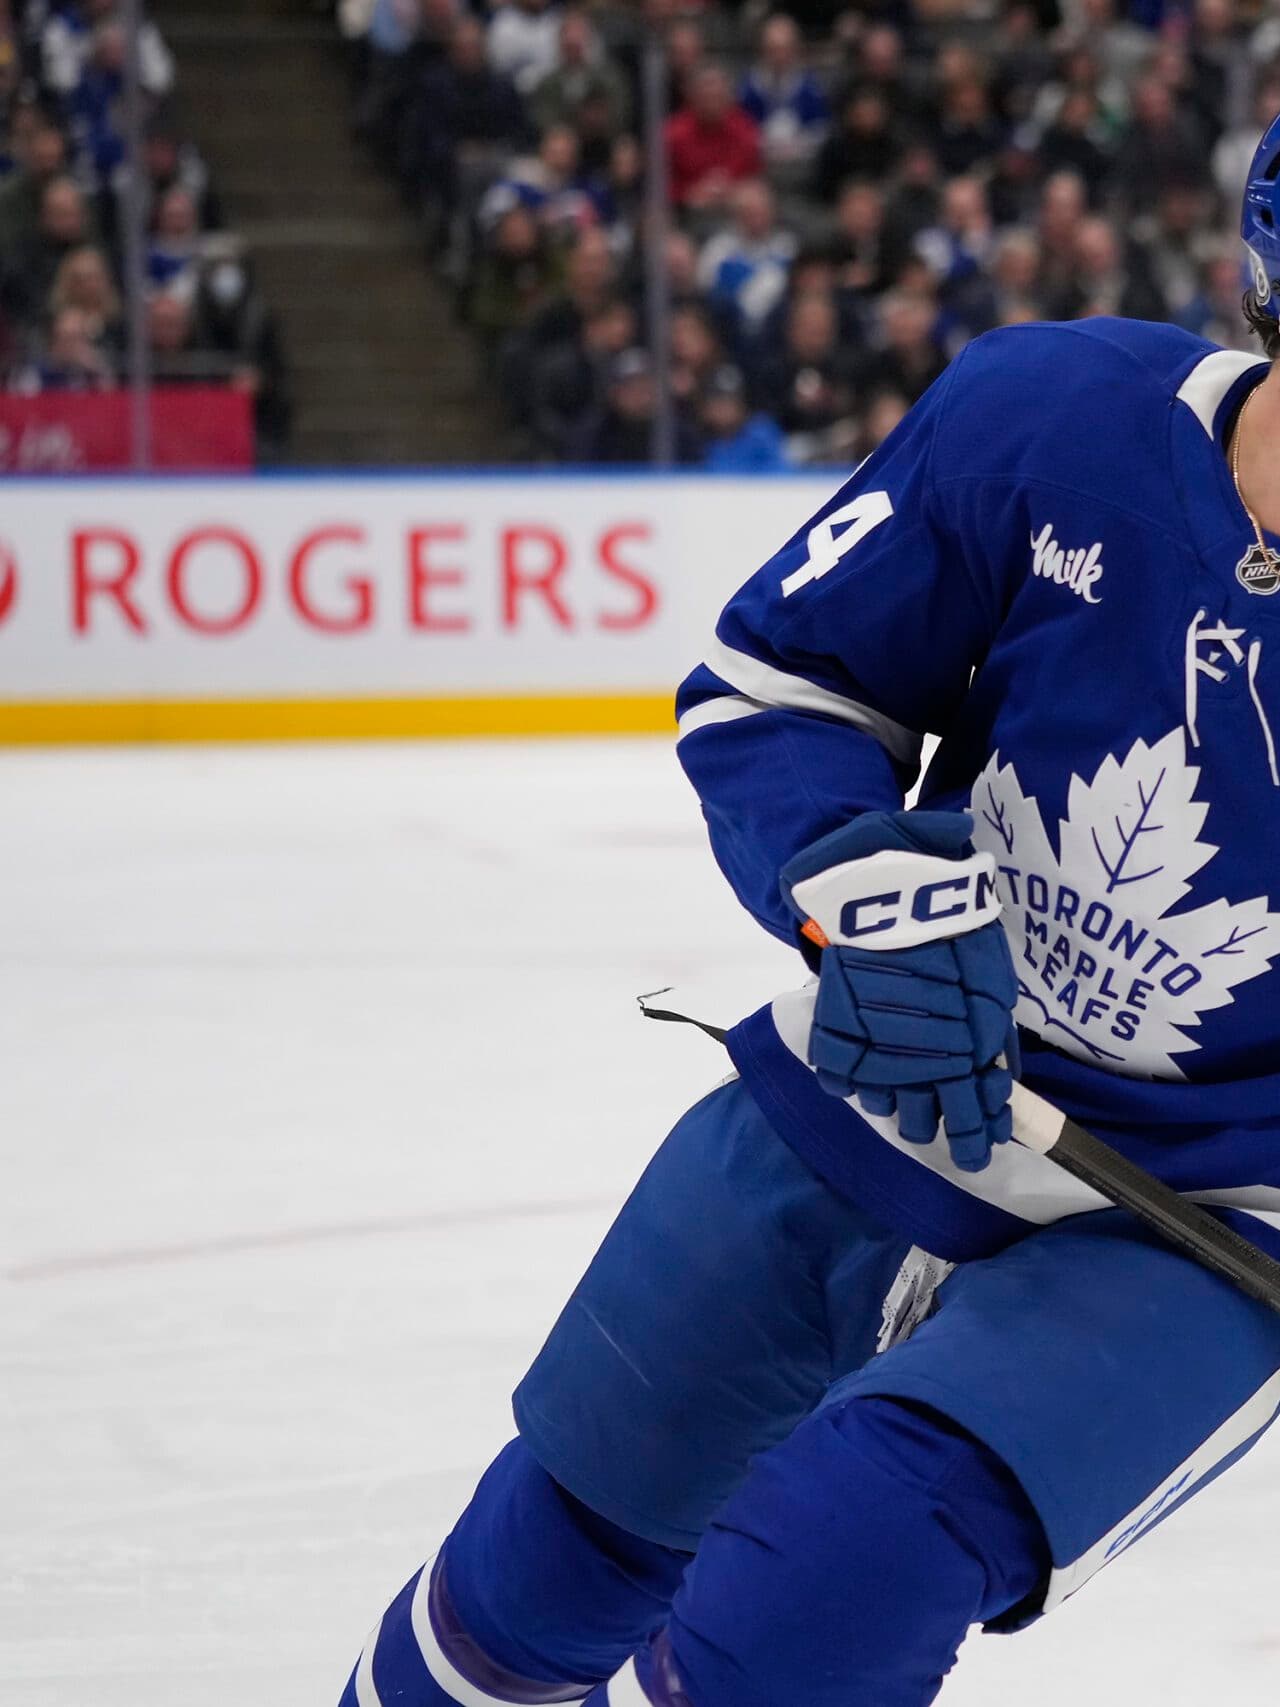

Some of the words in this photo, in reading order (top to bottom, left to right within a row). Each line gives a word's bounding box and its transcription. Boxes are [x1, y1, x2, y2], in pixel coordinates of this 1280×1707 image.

[70, 522, 660, 638] ROGERS
[998, 866, 1202, 997] TORONTO
[1026, 911, 1155, 1010] MAPLE
[1024, 936, 1140, 1041] LEAFS
